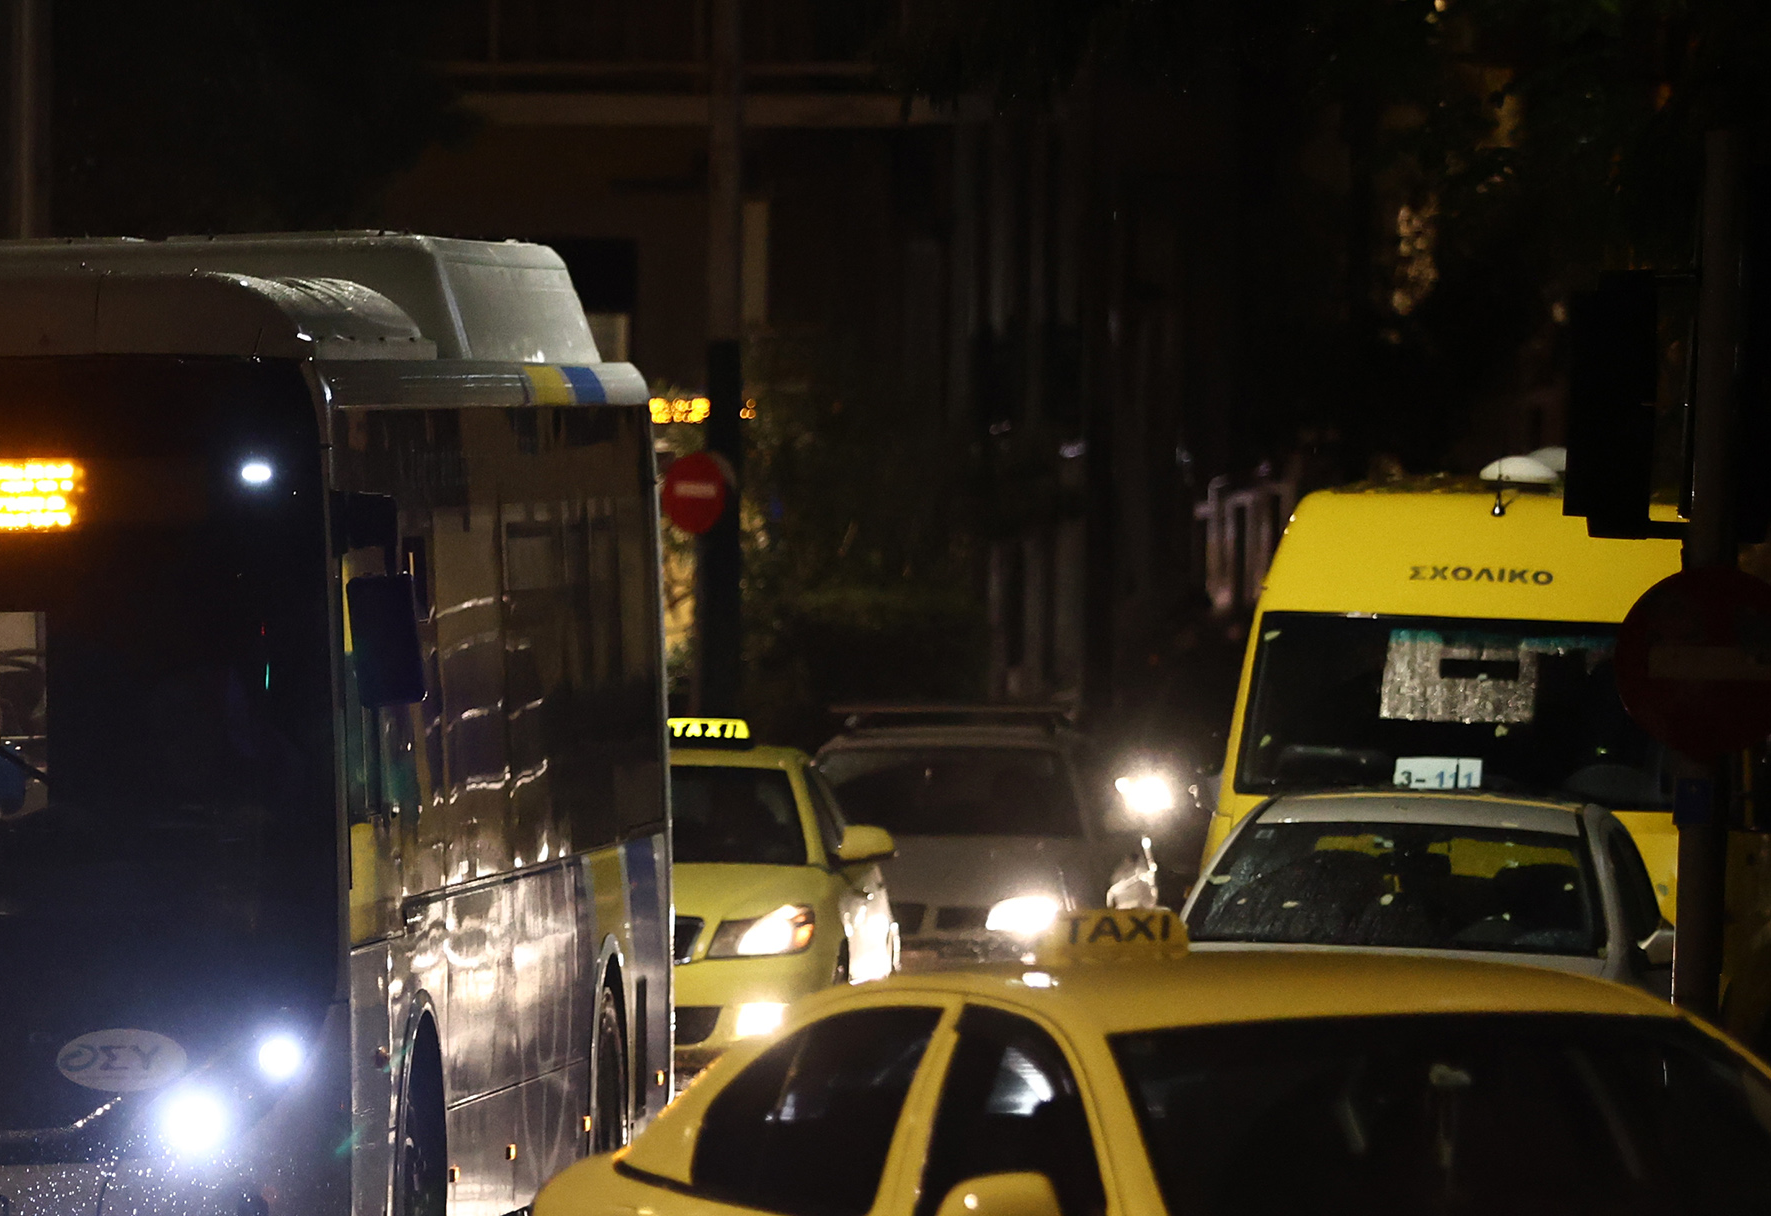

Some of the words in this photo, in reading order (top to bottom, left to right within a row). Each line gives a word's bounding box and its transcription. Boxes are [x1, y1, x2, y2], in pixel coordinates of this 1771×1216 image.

[1409, 565, 1554, 586] ΣΧΟΛΙΚΟ
[671, 721, 735, 740] TAXI
[1066, 914, 1171, 945] TAXI
